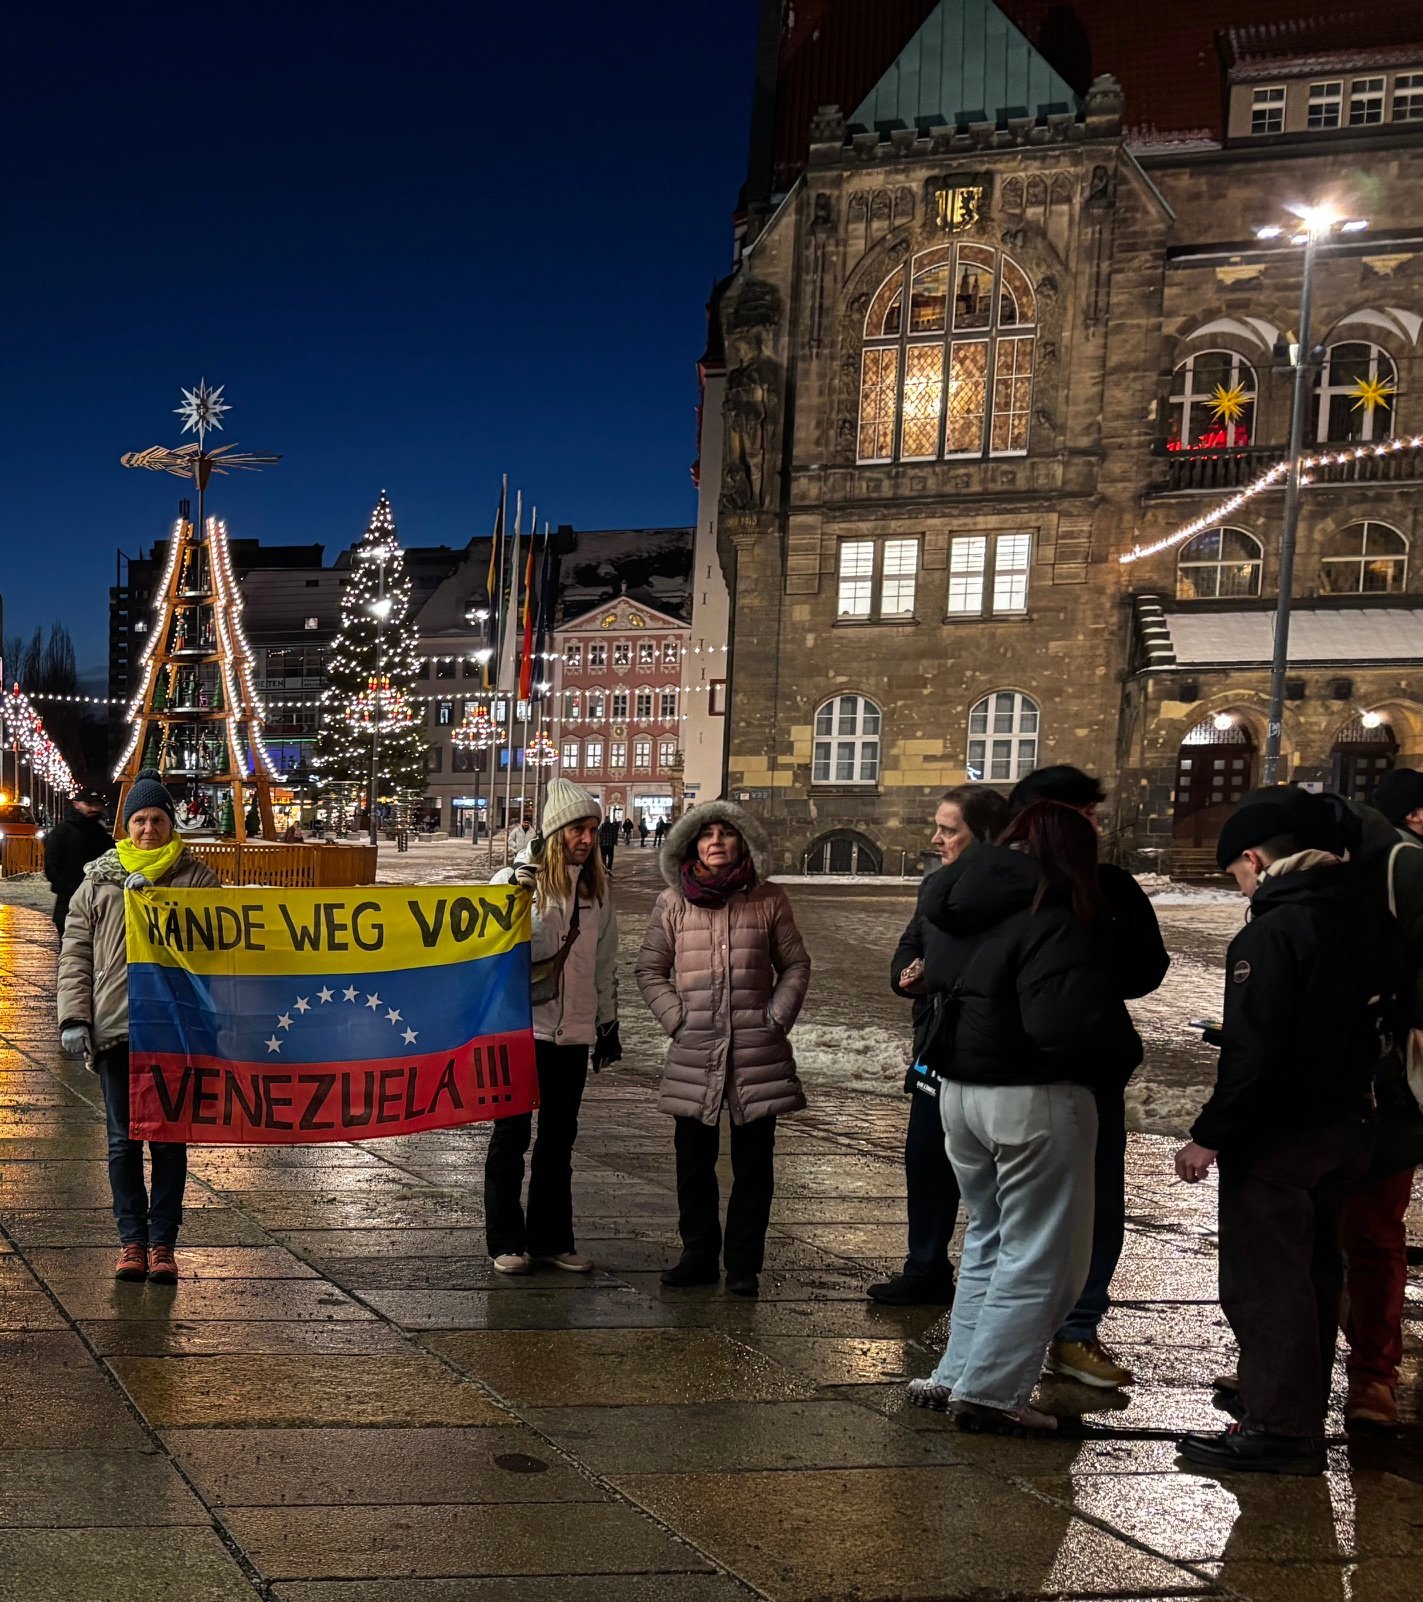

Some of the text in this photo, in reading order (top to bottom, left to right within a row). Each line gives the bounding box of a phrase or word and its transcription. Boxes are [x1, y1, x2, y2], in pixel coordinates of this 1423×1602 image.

[143, 894, 517, 952] HÄNDE WEG VON
